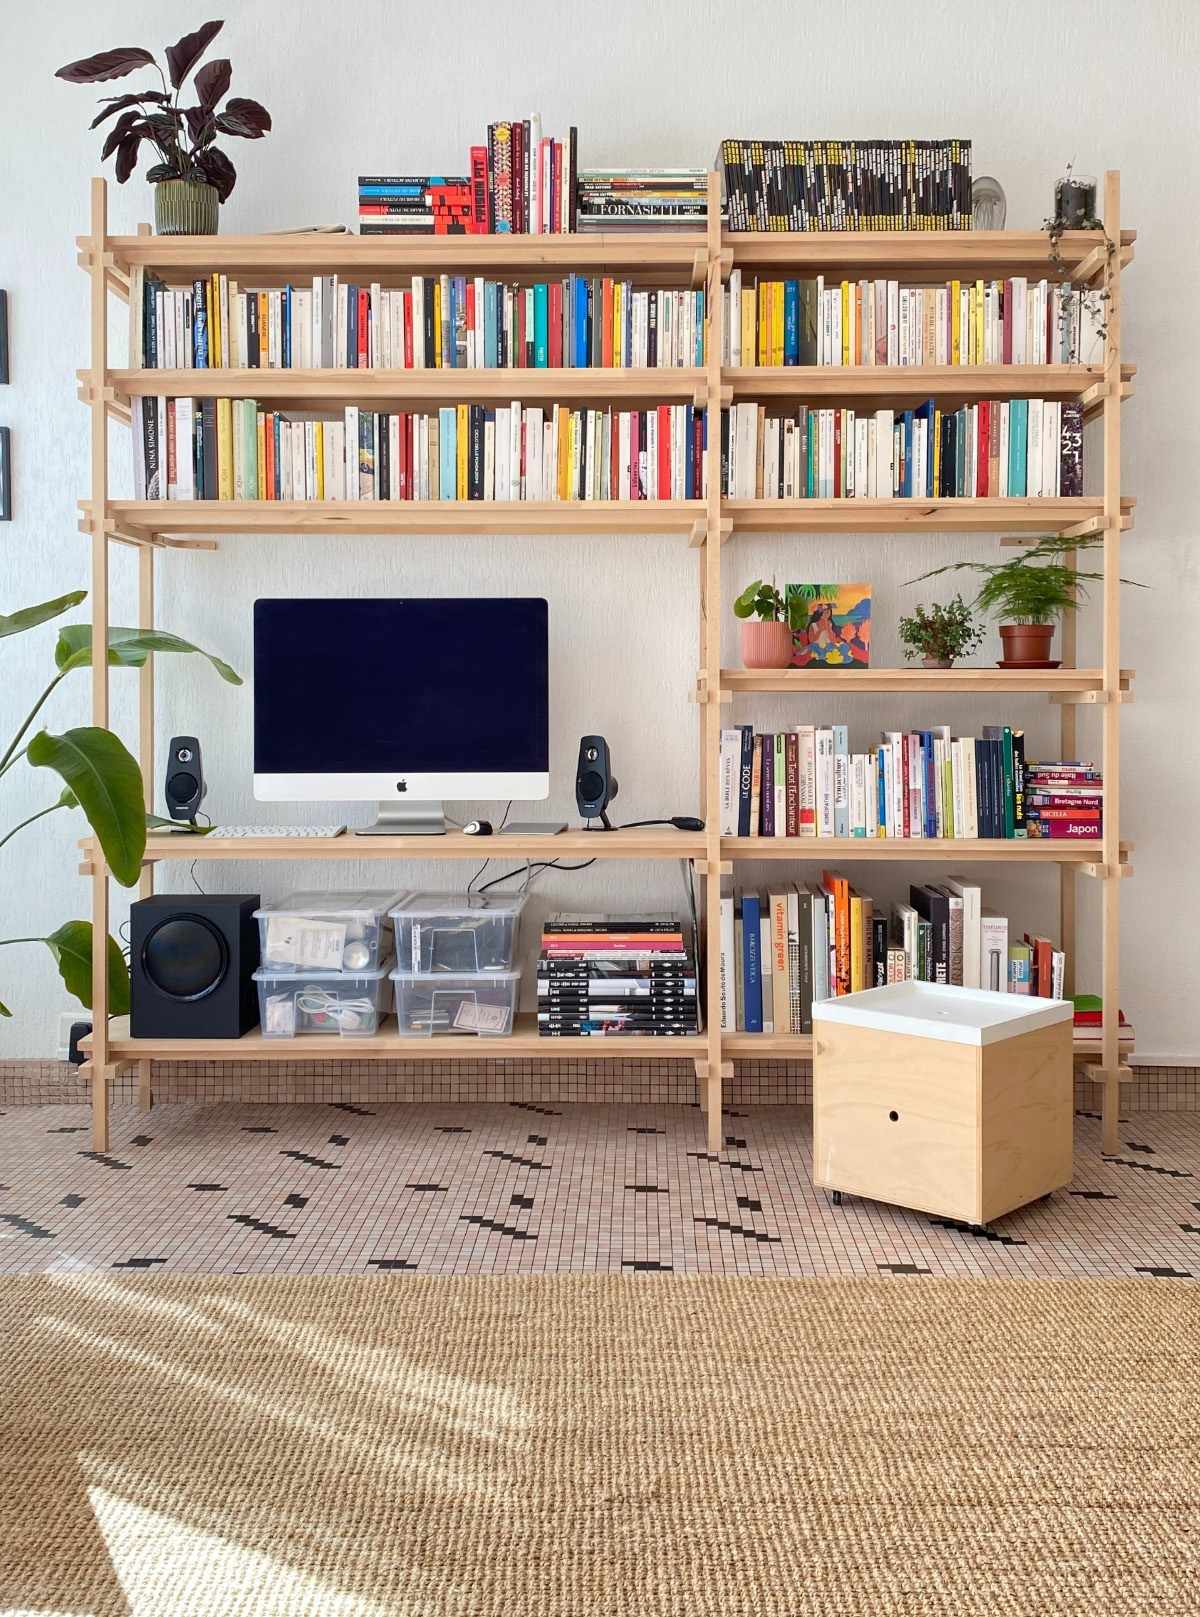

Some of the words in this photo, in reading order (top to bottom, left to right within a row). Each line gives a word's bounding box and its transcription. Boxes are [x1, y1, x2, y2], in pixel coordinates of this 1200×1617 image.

[475, 181, 486, 223] PRISON
[600, 204, 679, 215] FORNASETTI
[195, 281, 203, 309] DESPENTES
[147, 419, 155, 448] SIMONE
[1062, 425, 1071, 439] 4
[1072, 432, 1082, 447] 3
[1062, 441, 1072, 455] 2
[742, 764, 751, 790] CODE
[788, 762, 797, 783] Tarot
[743, 791, 749, 799] LE
[1054, 798, 1082, 806] Bretagne
[788, 784, 798, 834] l'Enchanteur
[1016, 805, 1024, 820] nuls
[1066, 823, 1098, 835] Japon
[776, 902, 786, 939] vitamin
[774, 942, 786, 971] green
[950, 947, 961, 982] RICK
[720, 973, 727, 981] de
[935, 962, 946, 984] RETE
